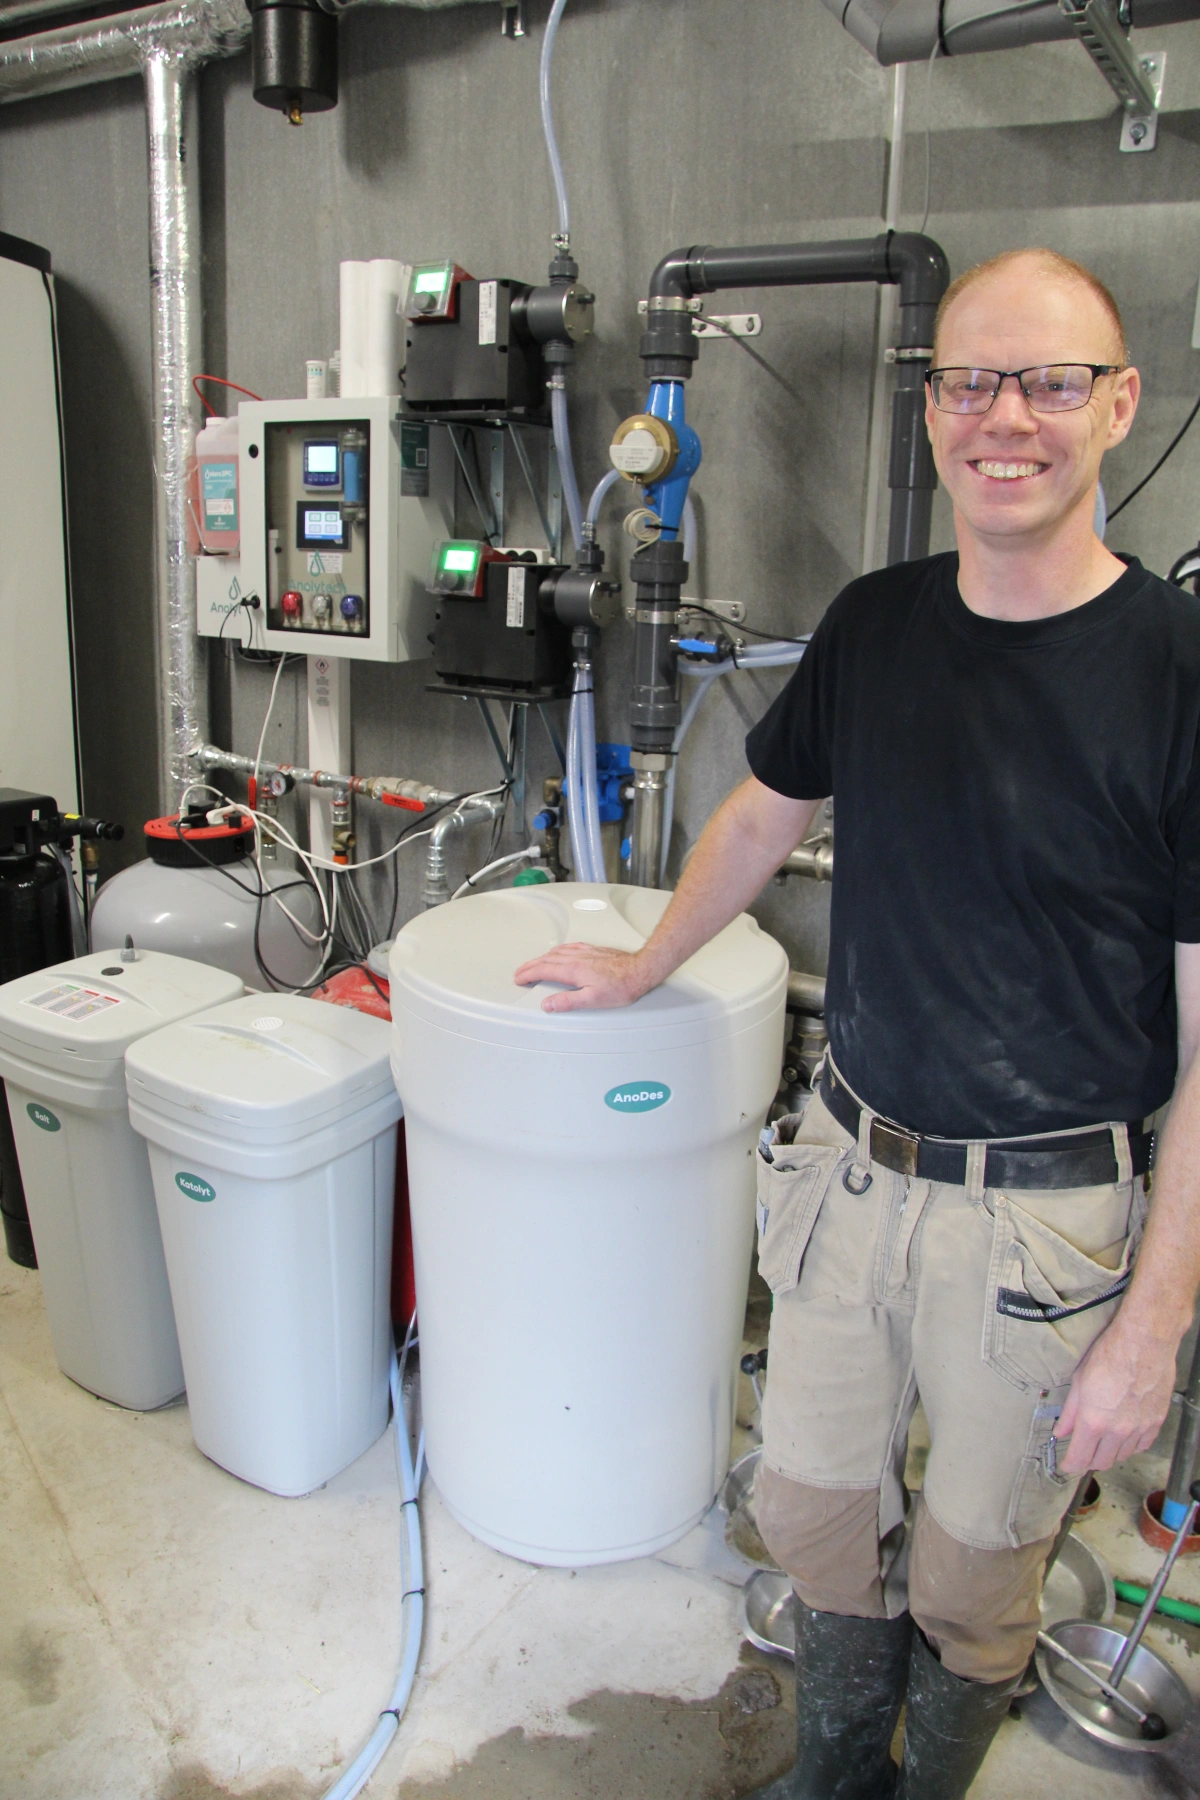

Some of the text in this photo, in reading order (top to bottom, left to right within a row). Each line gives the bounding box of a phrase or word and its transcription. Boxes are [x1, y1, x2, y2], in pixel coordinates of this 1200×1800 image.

[613, 1091, 664, 1103] AnoDes
[34, 1110, 50, 1124] Salt
[179, 1177, 211, 1197] Katolyt
